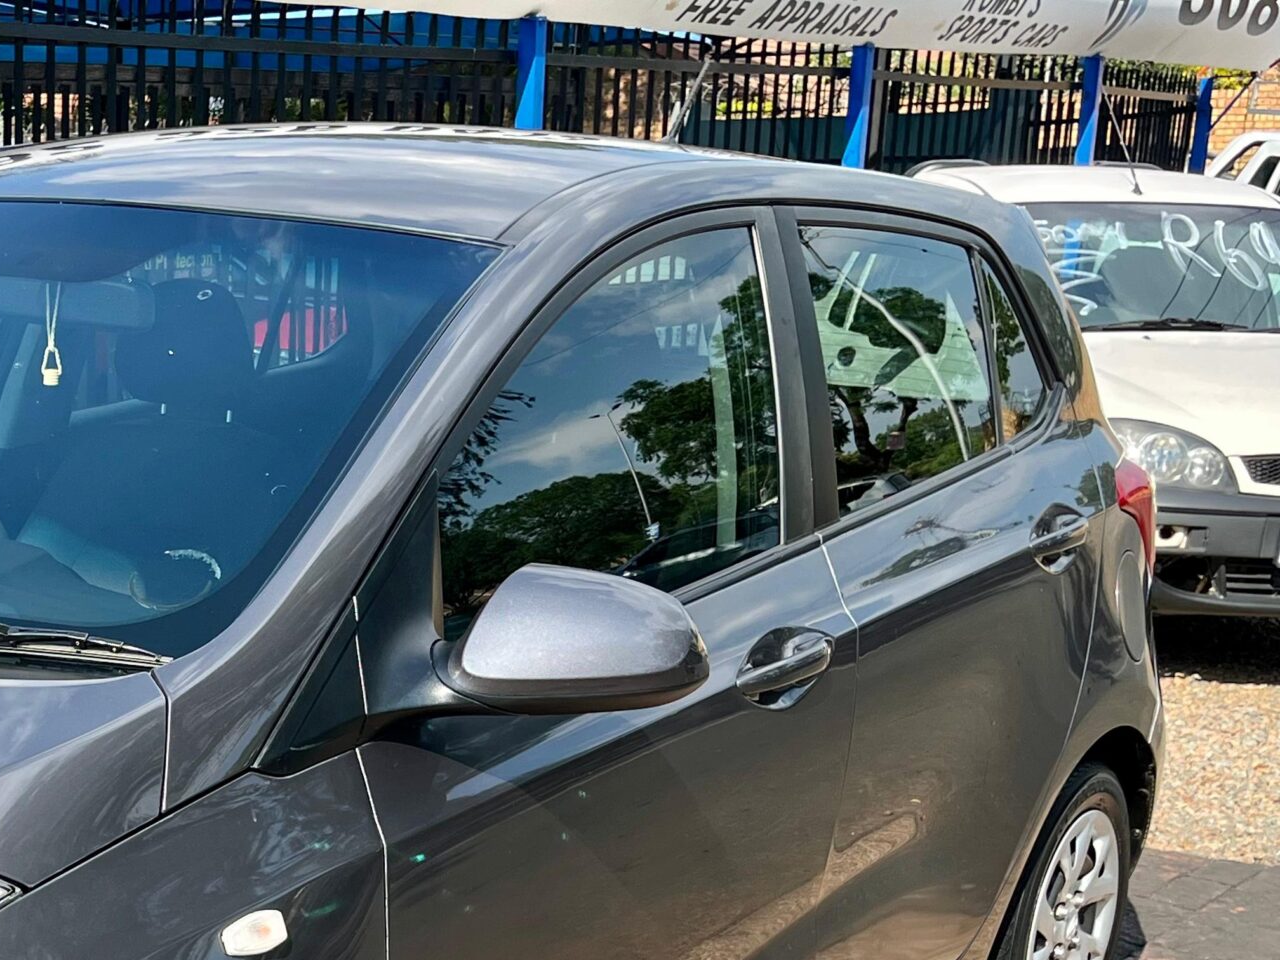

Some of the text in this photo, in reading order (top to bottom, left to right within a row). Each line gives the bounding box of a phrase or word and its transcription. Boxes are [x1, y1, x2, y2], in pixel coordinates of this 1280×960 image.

[675, 0, 898, 37] FREE APPRAISALS
[937, 14, 1069, 48] SPORTS CARS
